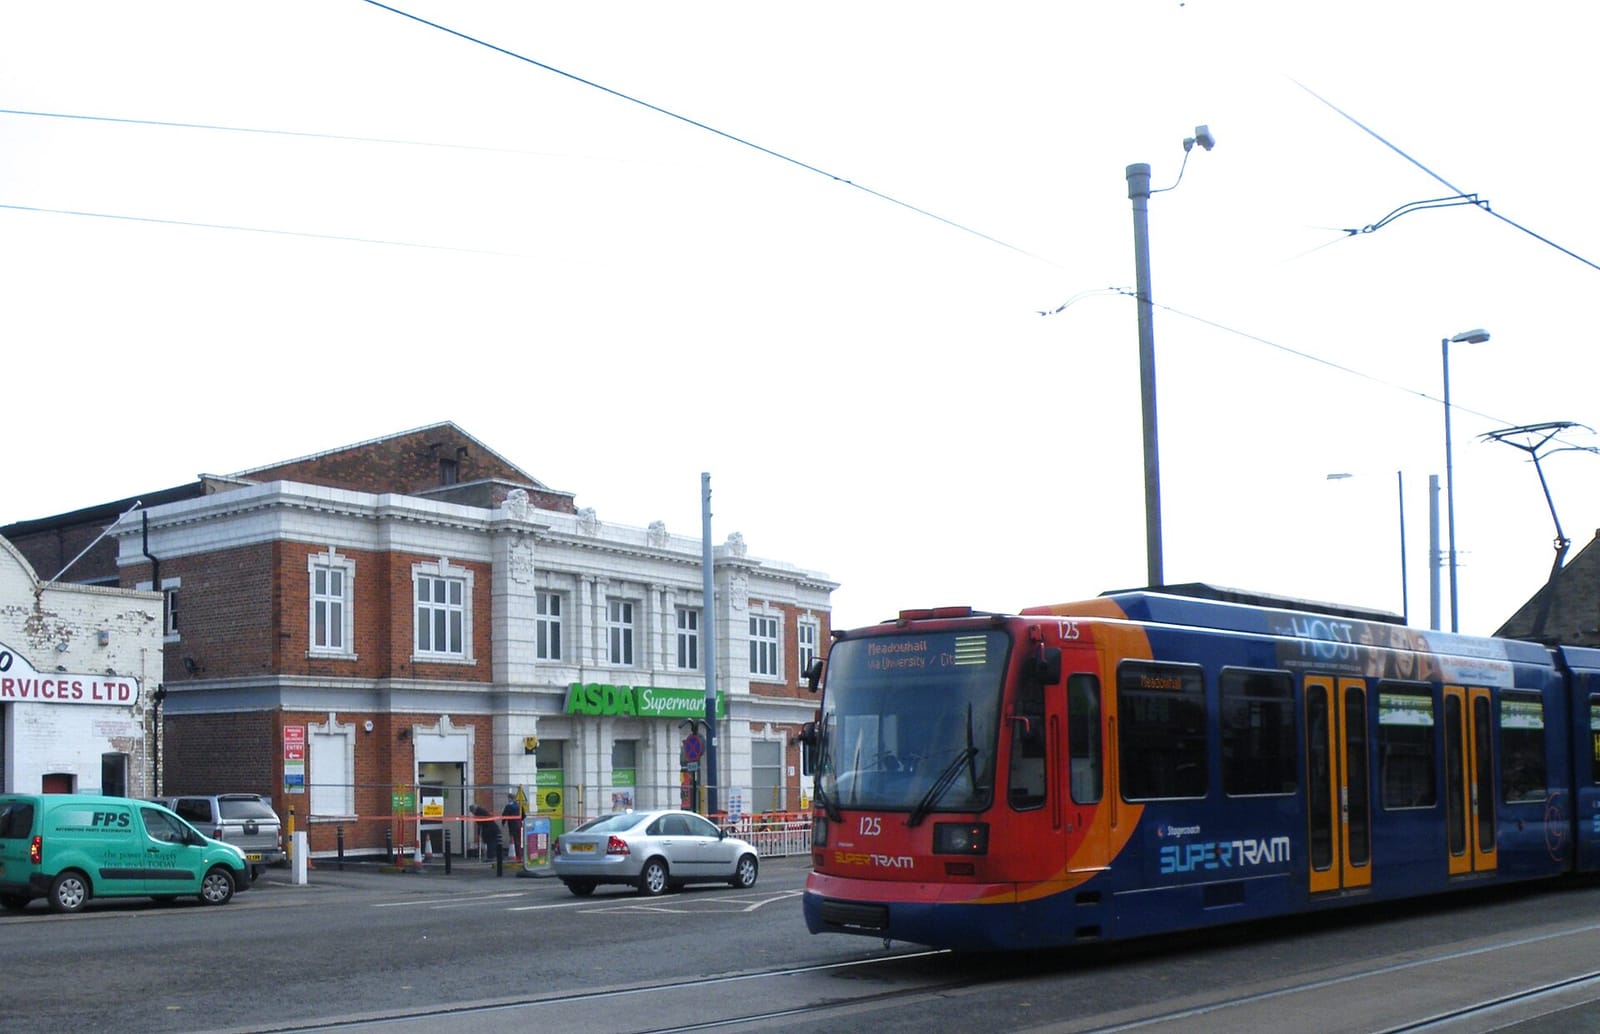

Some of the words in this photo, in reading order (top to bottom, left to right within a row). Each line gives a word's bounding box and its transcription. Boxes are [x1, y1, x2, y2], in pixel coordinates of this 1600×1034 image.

[1059, 620, 1080, 639] 125
[1292, 618, 1358, 660] HOST
[868, 641, 927, 655] Meadowhall
[882, 654, 925, 669] University
[940, 653, 956, 666] Cit
[92, 682, 130, 701] LTD
[564, 682, 637, 716] ASDA
[640, 689, 720, 714] Supermart
[91, 812, 130, 827] FPS
[859, 816, 881, 836] 125
[148, 860, 177, 868] TODAY
[834, 850, 914, 869] SUPERTRAM
[1160, 836, 1290, 874] SUPERTRAM
